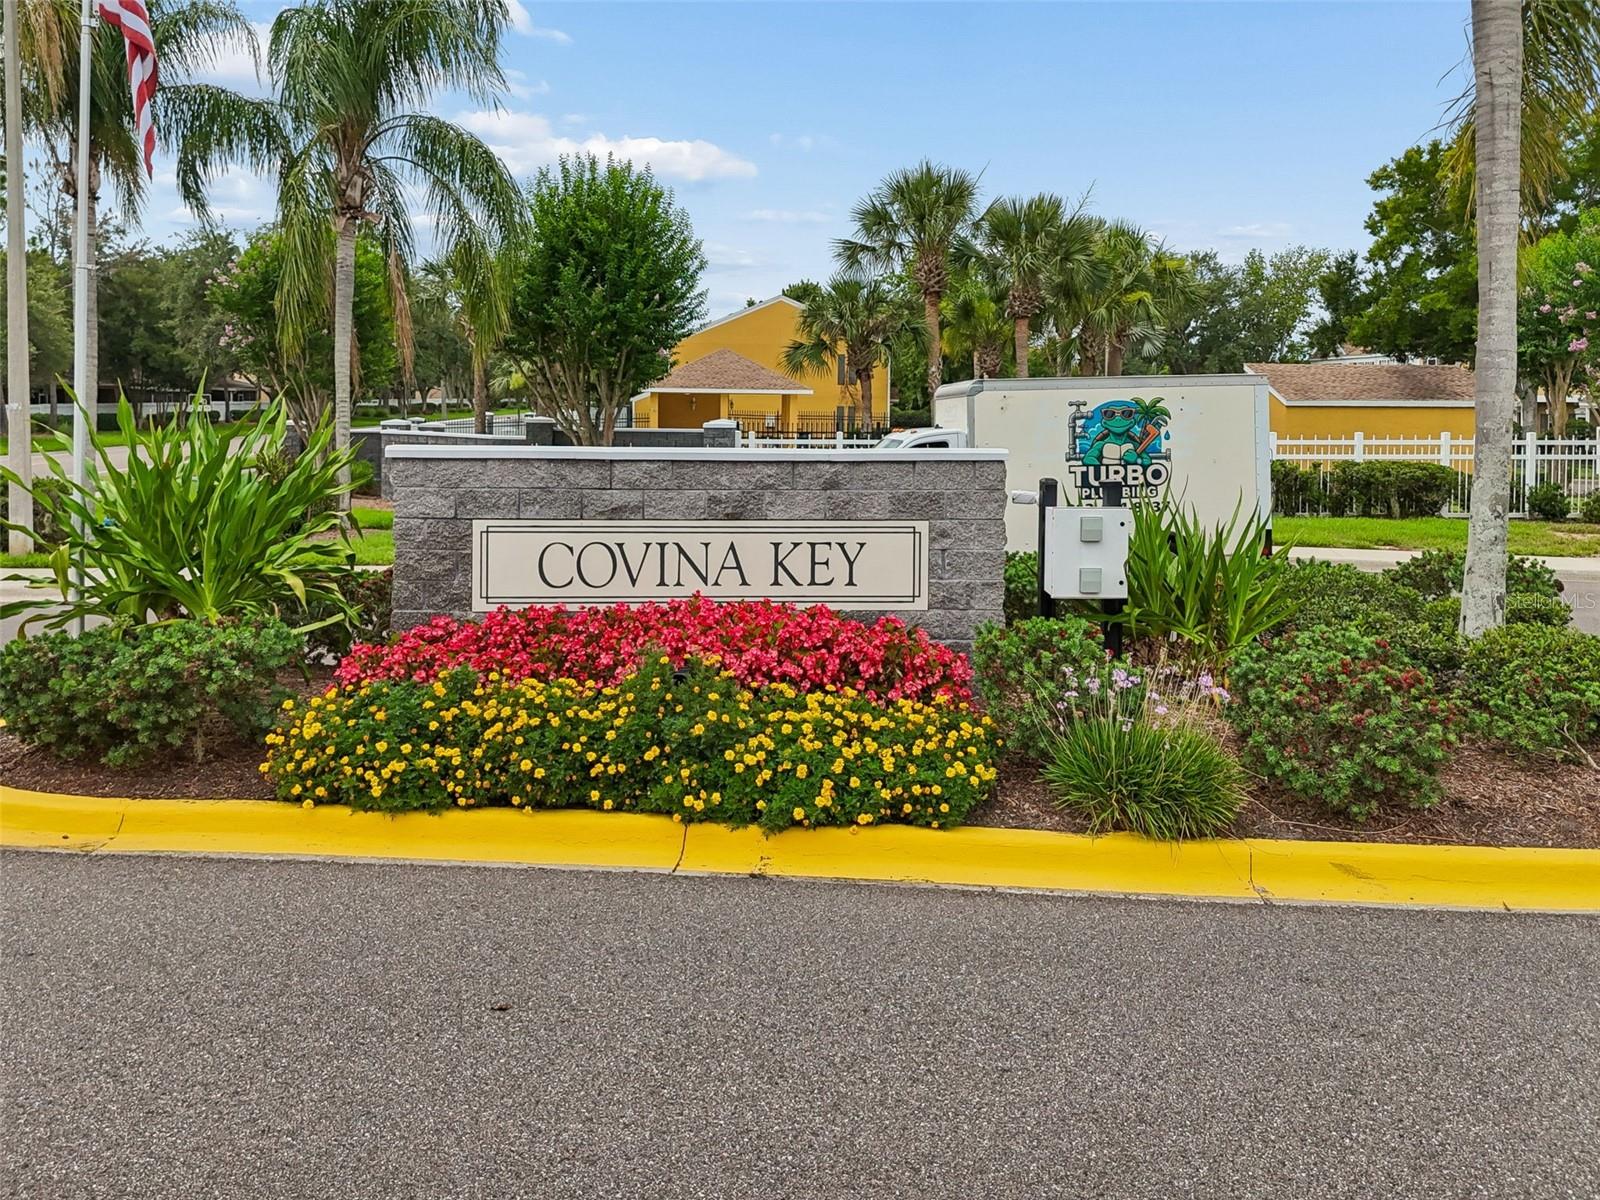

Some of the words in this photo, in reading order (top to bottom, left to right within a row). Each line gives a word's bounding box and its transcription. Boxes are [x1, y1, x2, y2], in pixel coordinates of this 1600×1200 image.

[1069, 463, 1168, 488] TURBO
[1081, 486, 1158, 499] PLBING
[538, 541, 751, 588] COVINA
[770, 541, 867, 587] KEY
